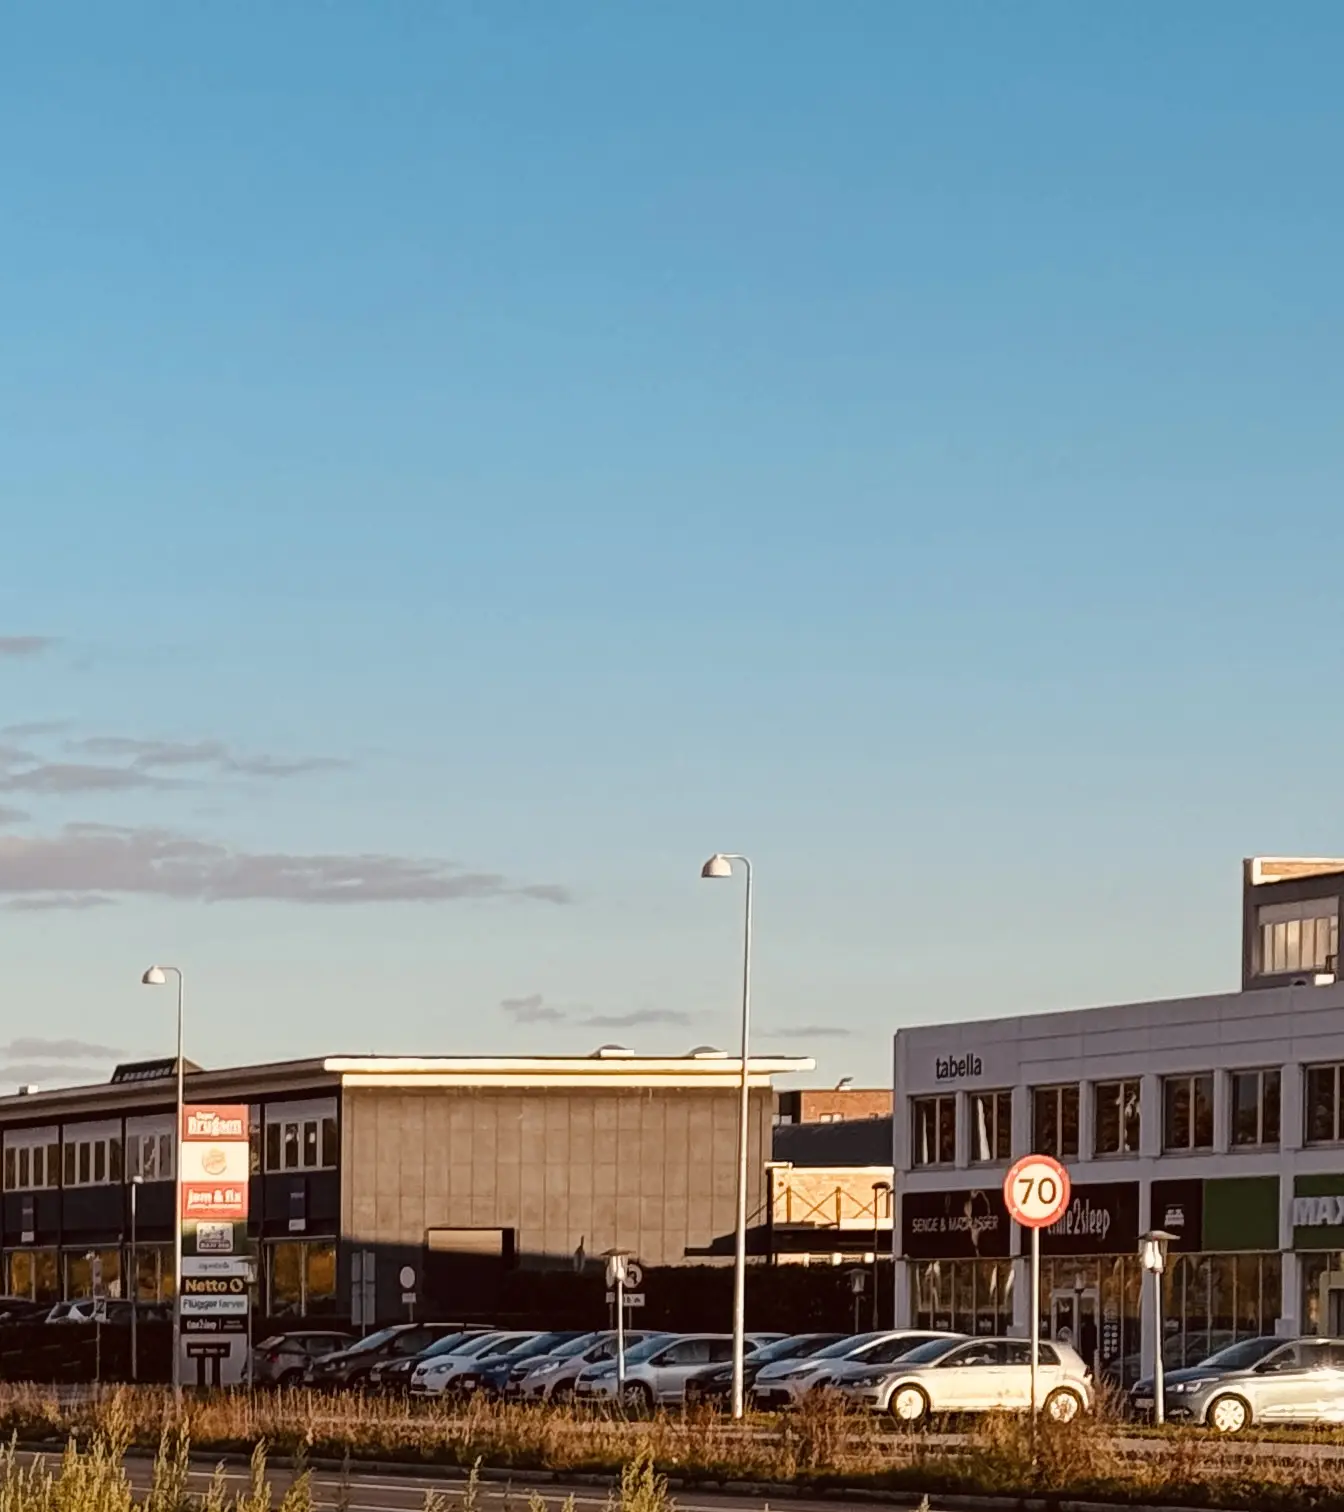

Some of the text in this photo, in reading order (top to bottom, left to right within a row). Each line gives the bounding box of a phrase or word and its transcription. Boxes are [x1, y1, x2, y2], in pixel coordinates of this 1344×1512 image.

[935, 1053, 982, 1079] tabella
[1018, 1177, 1057, 1205] 70
[912, 1217, 938, 1233] SENGE
[184, 1279, 228, 1293] Netto
